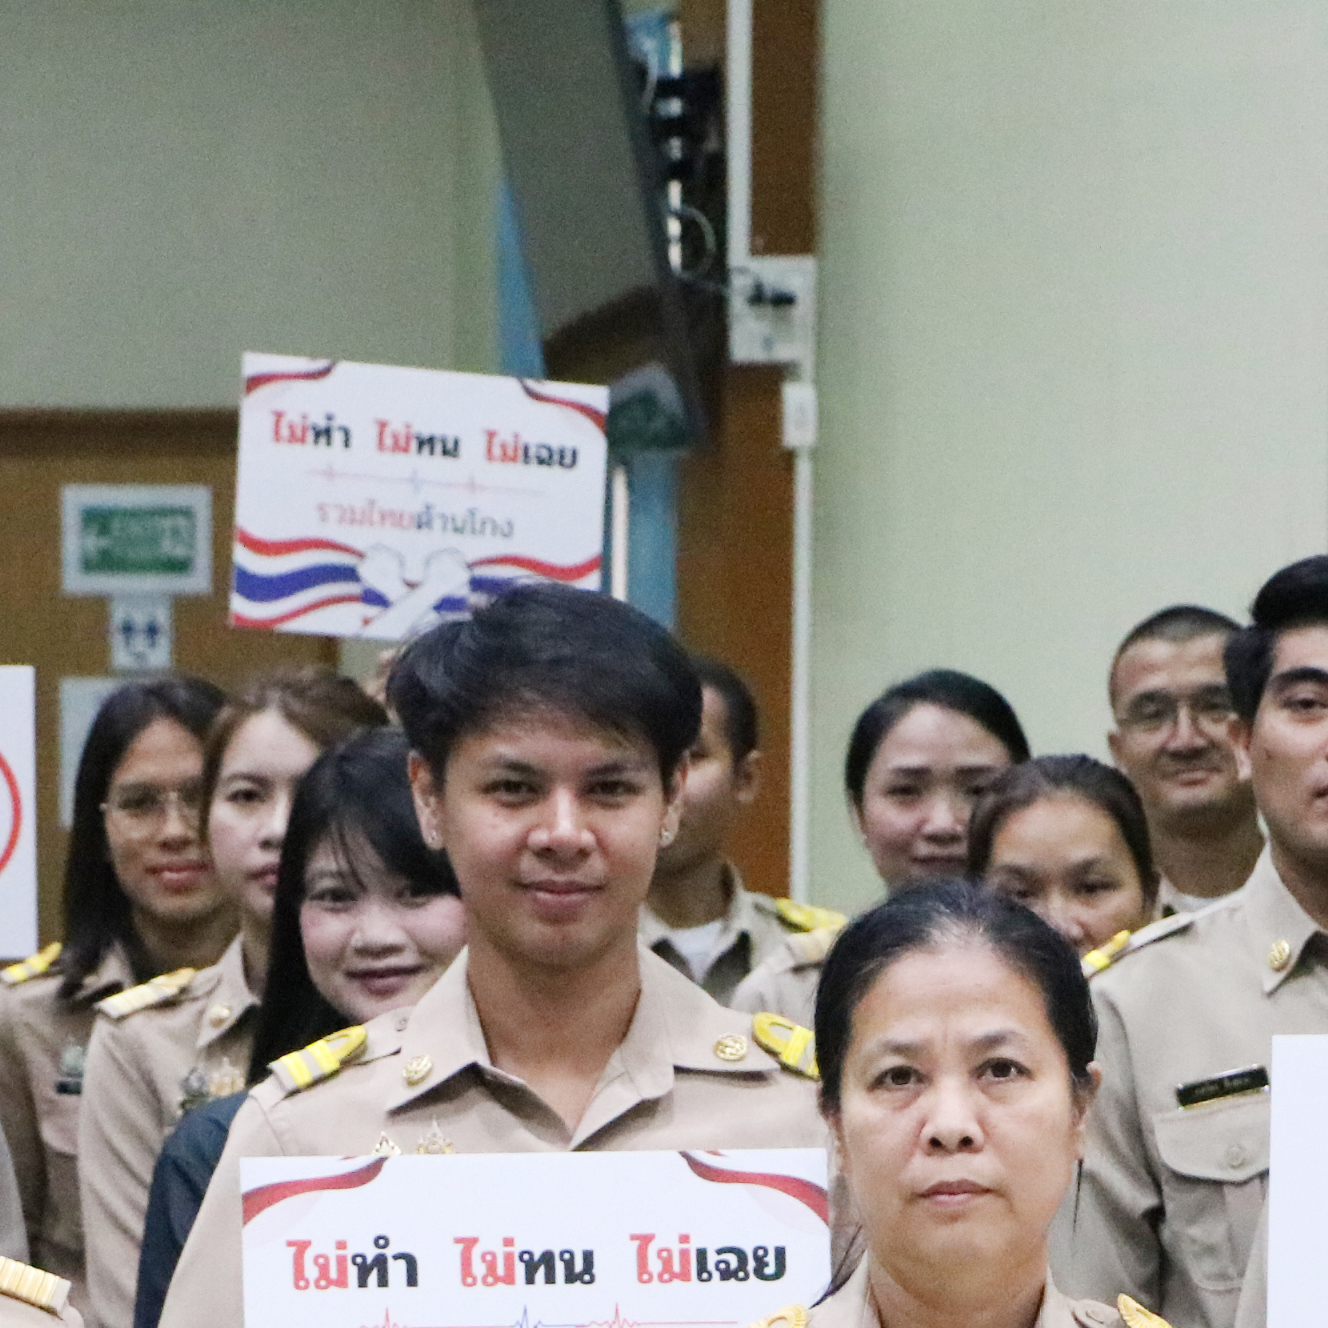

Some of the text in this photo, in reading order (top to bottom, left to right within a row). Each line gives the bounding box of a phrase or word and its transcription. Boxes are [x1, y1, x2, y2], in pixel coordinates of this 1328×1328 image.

[272, 409, 578, 470] ไม่ทำ ไม่ทน ไม่เฉย
[286, 1233, 786, 1291] ไม่ทำ ไม่ทน ไม่เฉย
